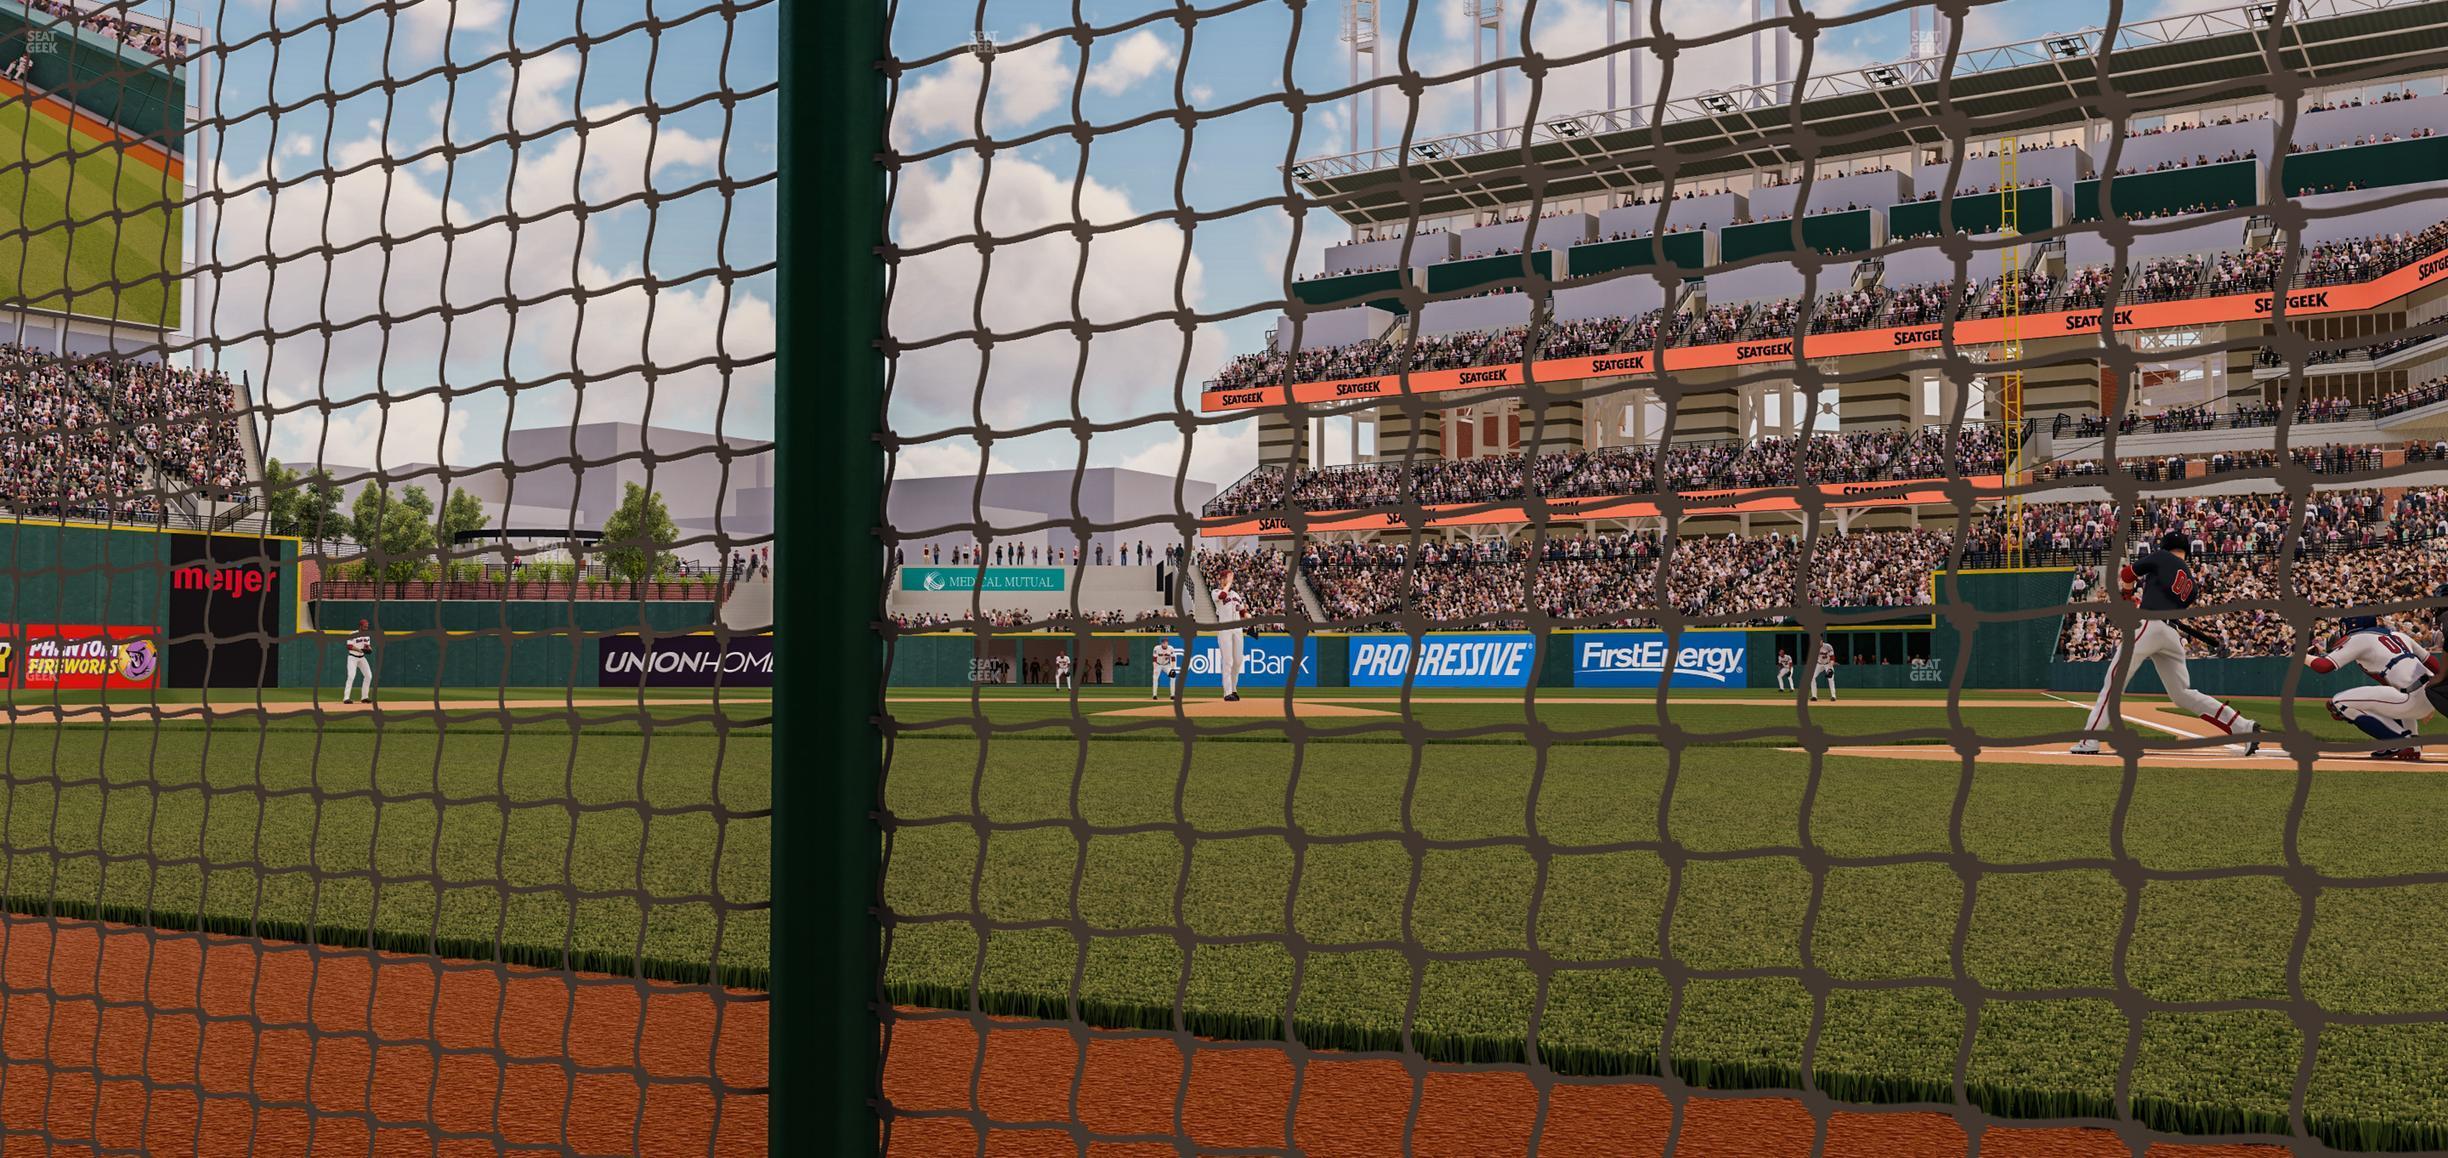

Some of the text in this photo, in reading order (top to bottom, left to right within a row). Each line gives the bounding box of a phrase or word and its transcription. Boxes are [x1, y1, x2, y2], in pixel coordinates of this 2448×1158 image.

[1736, 341, 1793, 360] SEATGEEK
[1592, 355, 1645, 373] SEATGEEK
[1459, 368, 1507, 385] SEATGEEK
[1336, 380, 1381, 396] SEATGEEK
[1222, 391, 1264, 406] SEATGEEK
[174, 563, 277, 598] meijer
[1004, 576, 1054, 588] MUTUAL
